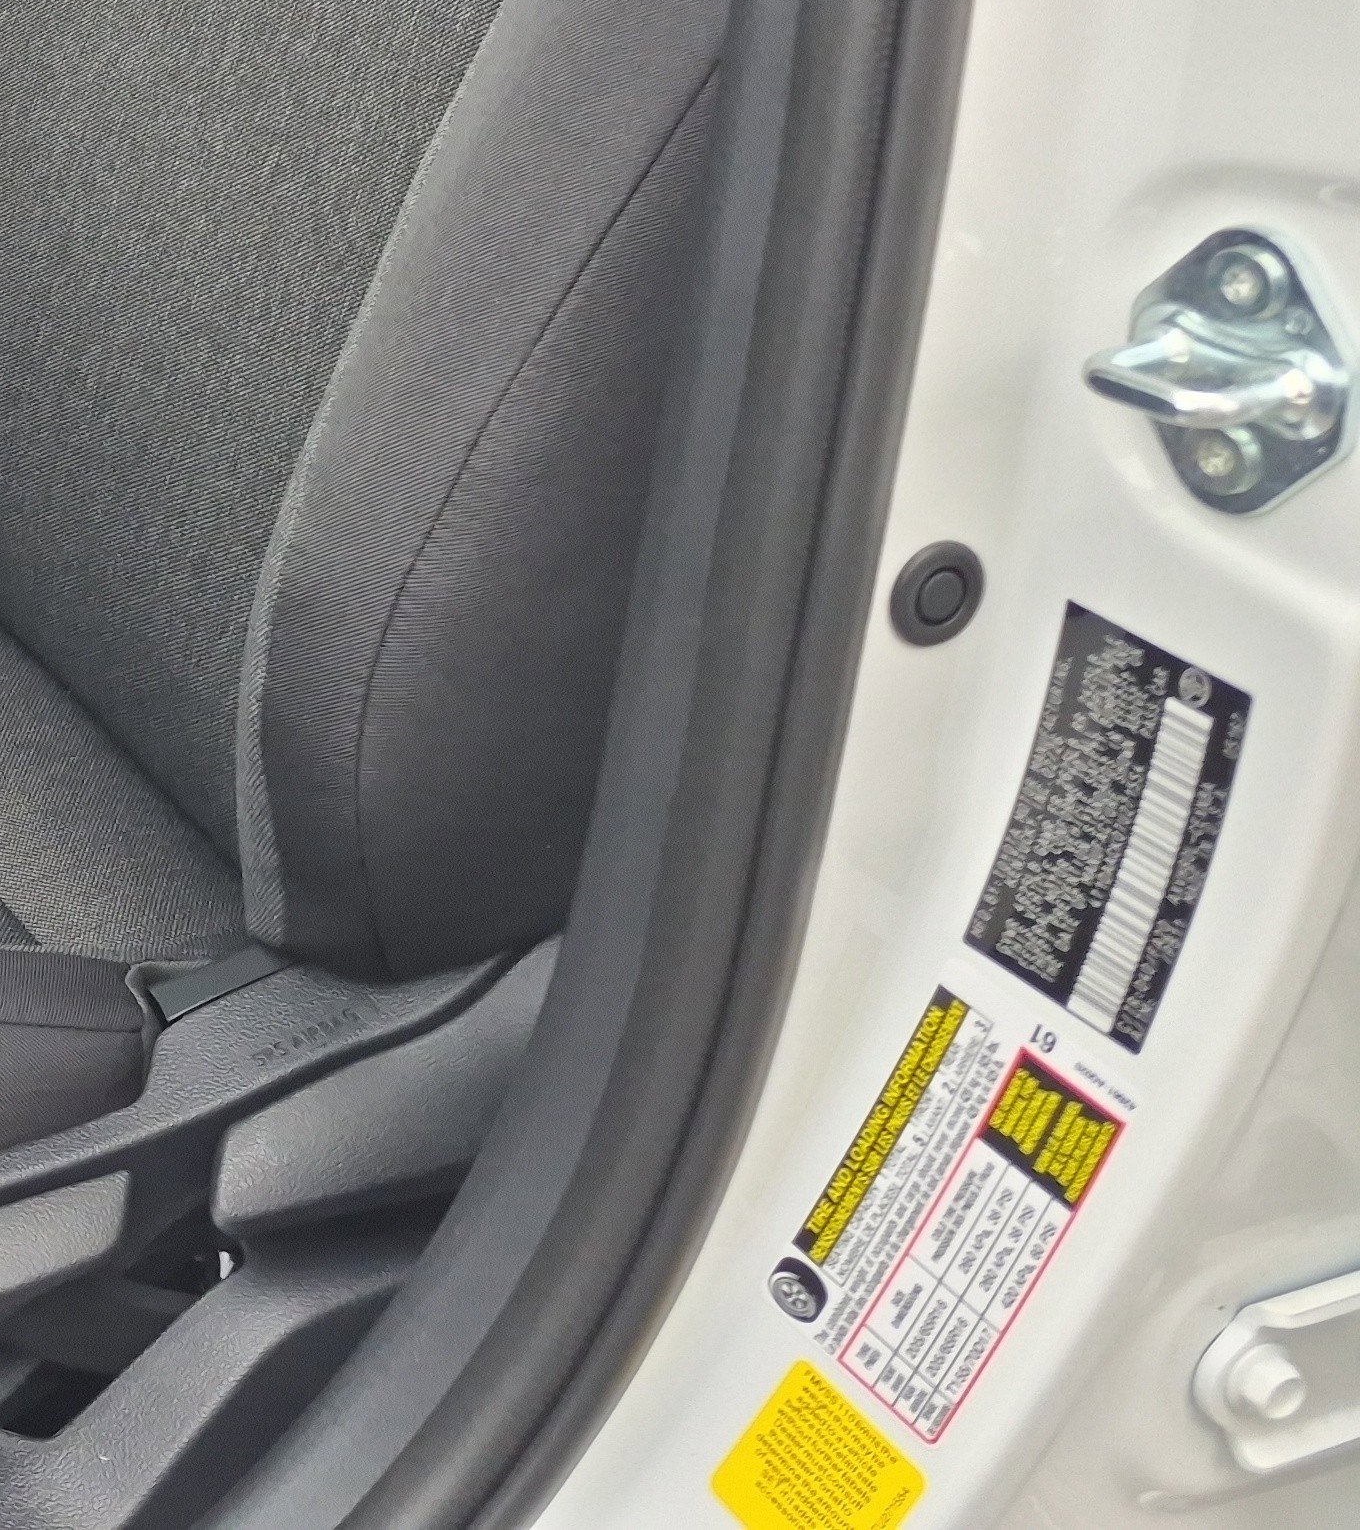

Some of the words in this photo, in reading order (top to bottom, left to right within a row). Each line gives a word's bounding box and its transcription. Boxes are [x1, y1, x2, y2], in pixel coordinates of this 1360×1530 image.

[804, 1195, 836, 1237] TIRE
[824, 1164, 855, 1205] AND
[843, 1101, 892, 1173] LOADING
[878, 1004, 947, 1108] INFORMATION
